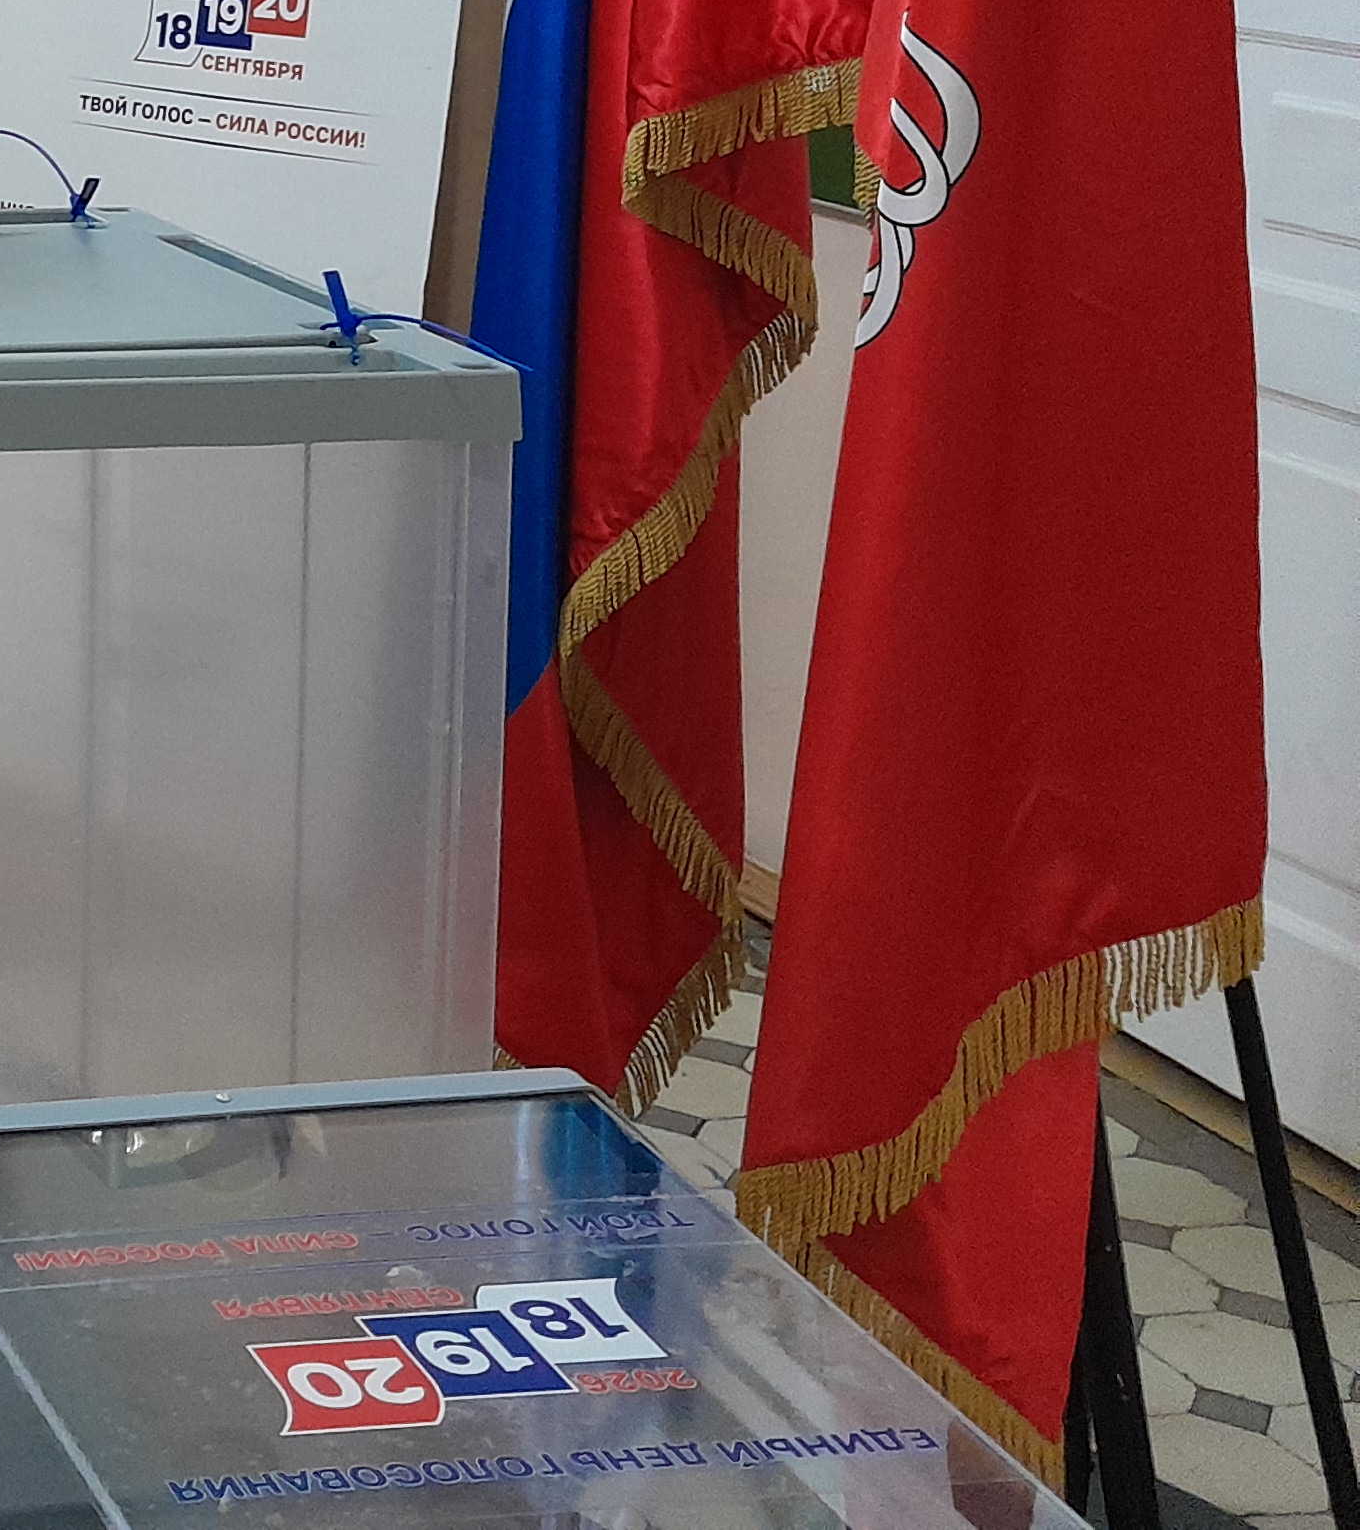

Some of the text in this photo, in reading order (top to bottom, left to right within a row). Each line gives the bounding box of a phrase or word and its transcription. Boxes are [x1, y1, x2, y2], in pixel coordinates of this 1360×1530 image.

[156, 13, 192, 50] 18
[202, 54, 303, 81] СЕНТЯБРЯ
[80, 95, 127, 115] ТВОЙ
[132, 102, 193, 124] ГОЛОС
[217, 114, 269, 135] СИЛА
[275, 122, 365, 148] РОССИИ!
[229, 1231, 358, 1254] СИЛА
[407, 1215, 560, 1244] ГОЛОС
[13, 1240, 225, 1271] РОССИИ!
[214, 1286, 465, 1321] СЕНТЯБРЯ
[287, 1298, 629, 1409] 18 19 20
[576, 1368, 698, 1393] 2026
[169, 1428, 940, 1504] ЕДИНЫЙ ДЕНЬ ГОЛОСОВАНИЯ
